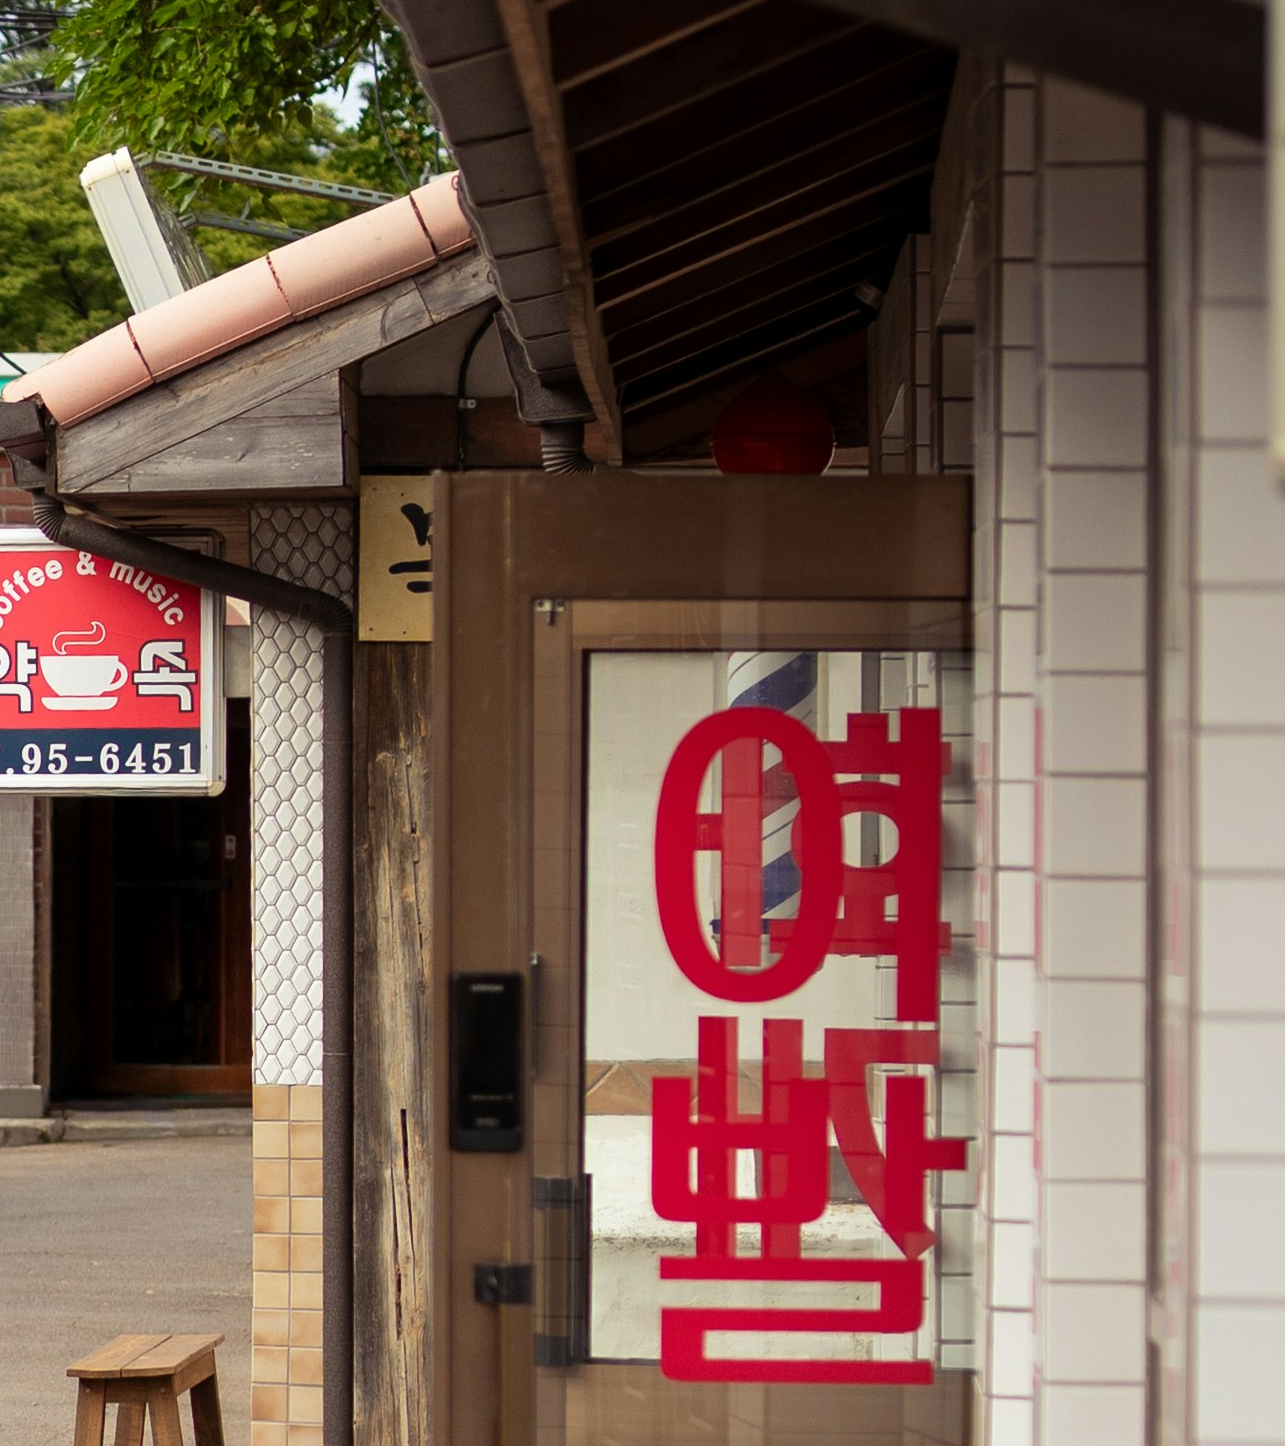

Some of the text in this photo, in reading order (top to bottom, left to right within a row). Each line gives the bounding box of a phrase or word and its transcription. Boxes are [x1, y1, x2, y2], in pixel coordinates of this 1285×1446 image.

[77, 551, 96, 576] &
[109, 559, 184, 626] music
[651, 706, 967, 1385] 이발
